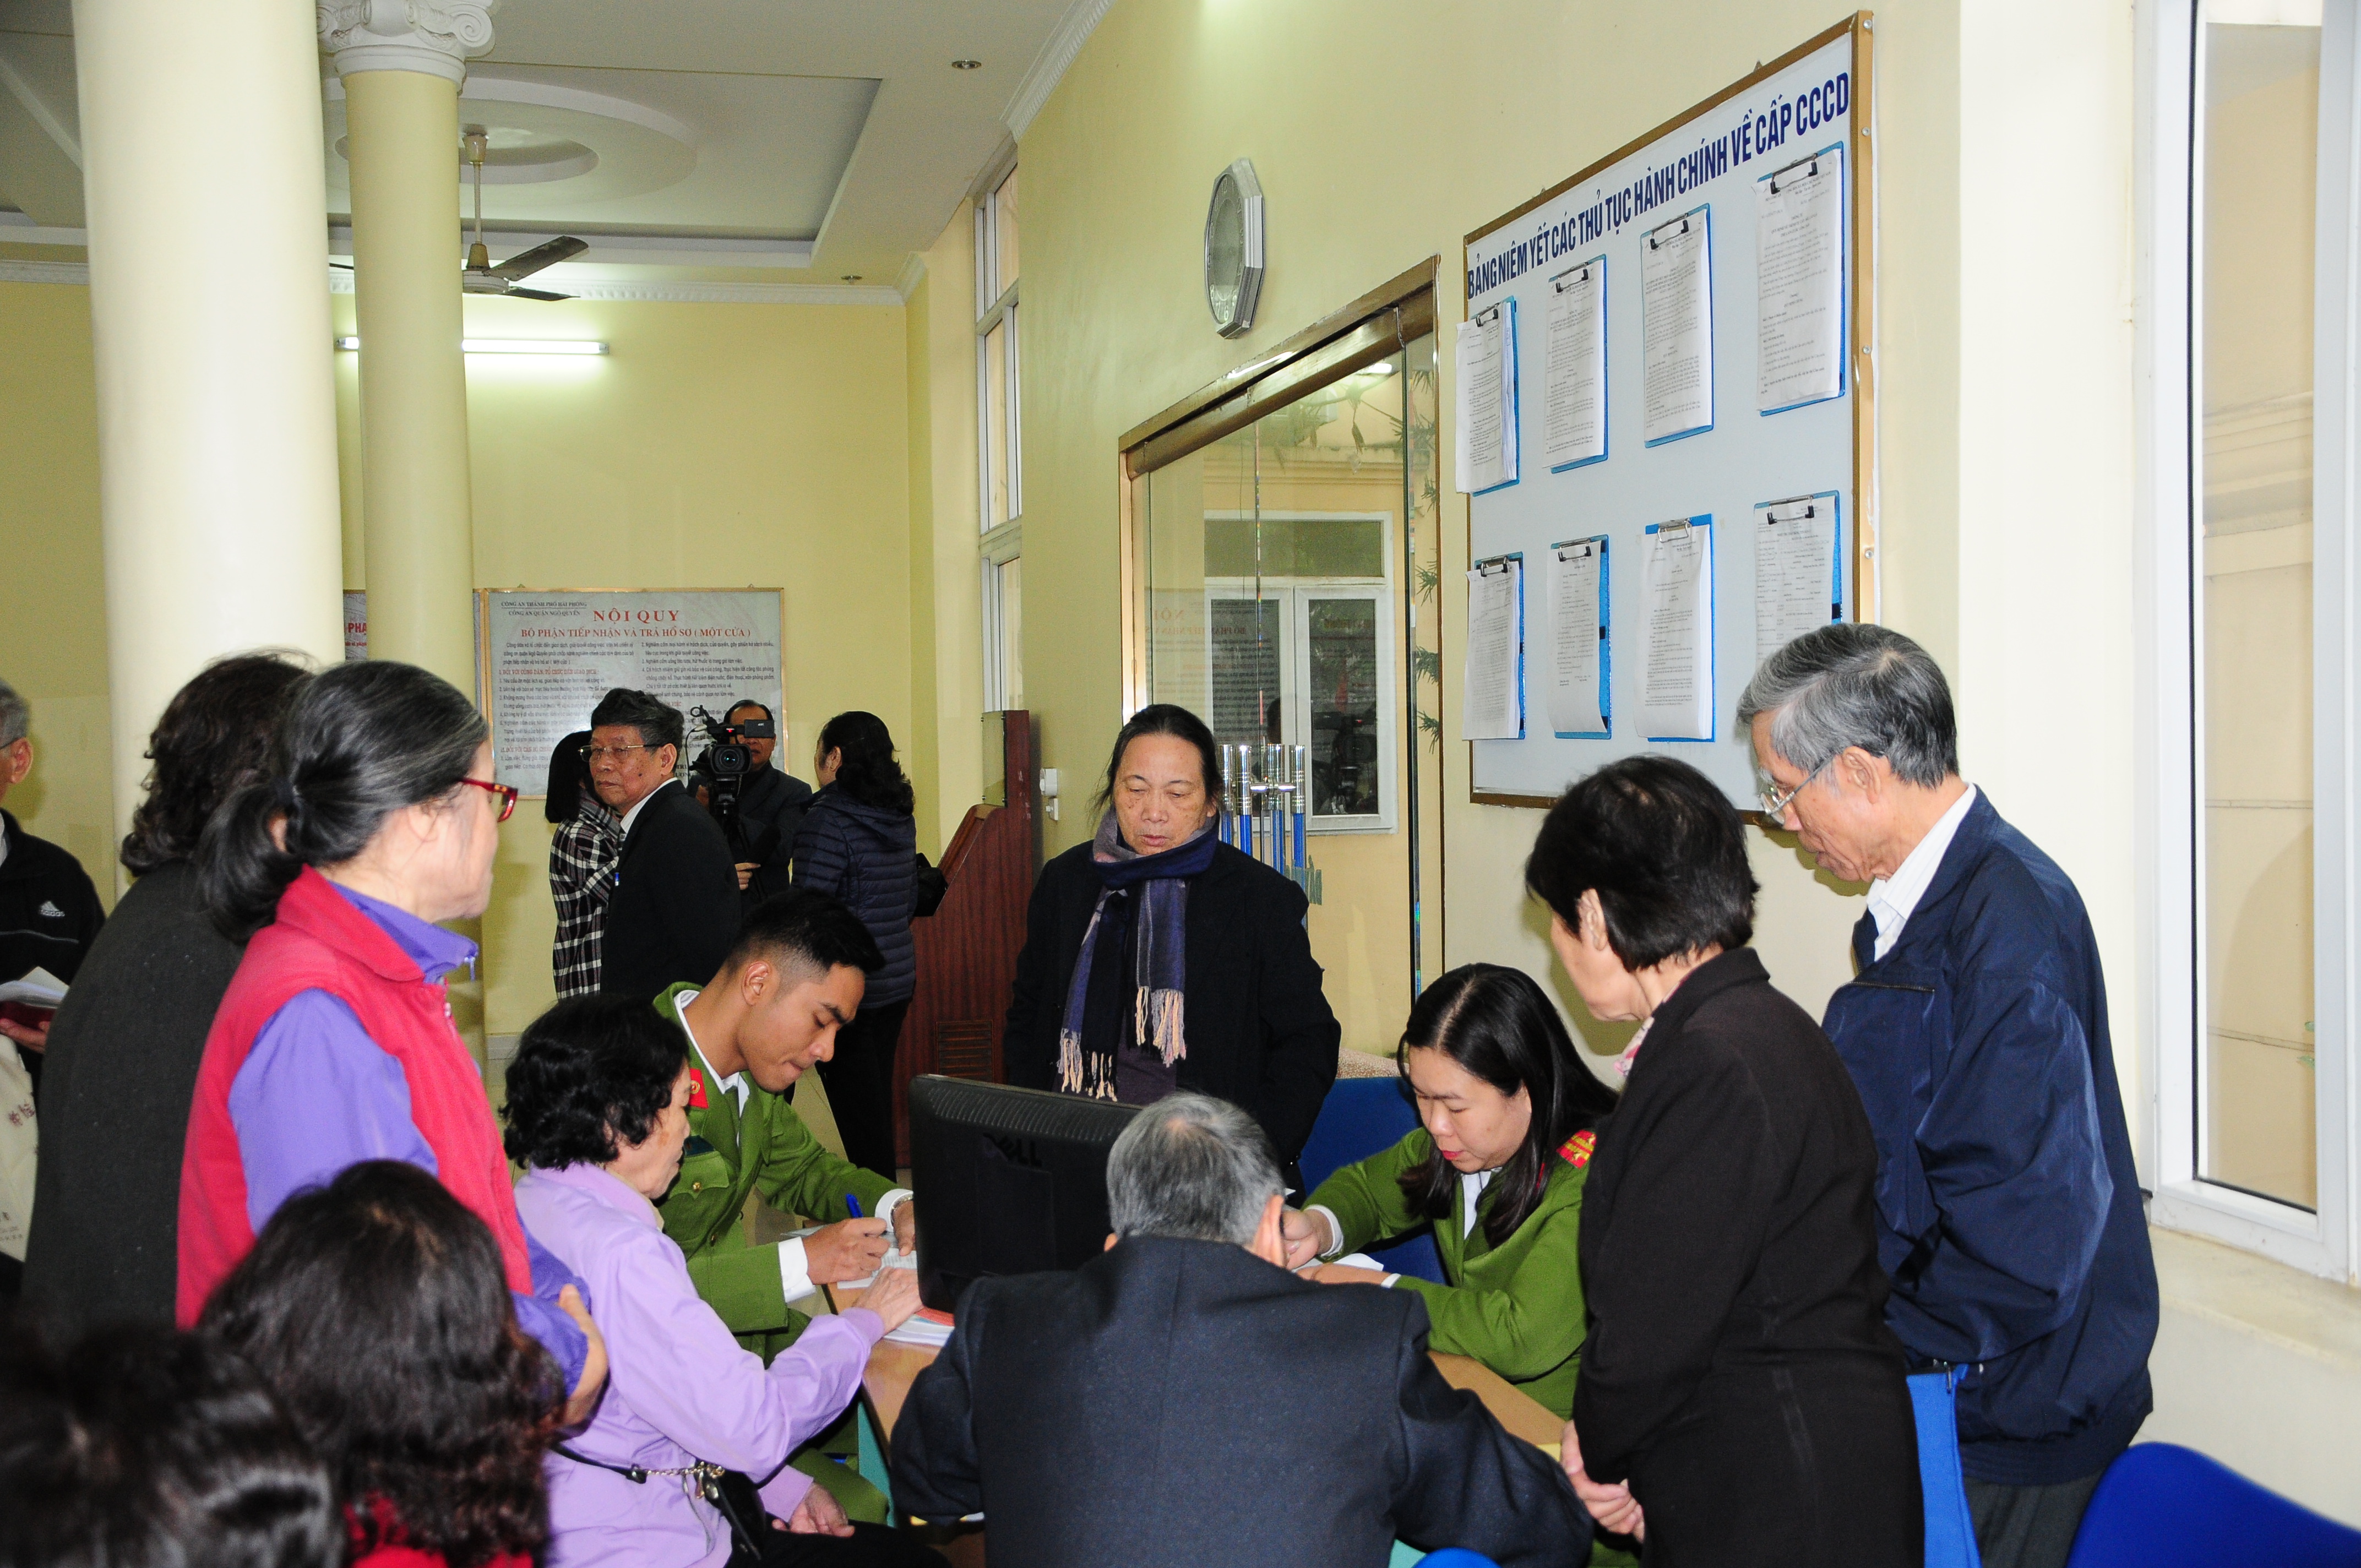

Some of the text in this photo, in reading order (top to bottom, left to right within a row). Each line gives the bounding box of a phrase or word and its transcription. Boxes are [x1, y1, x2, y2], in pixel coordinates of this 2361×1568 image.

[1468, 72, 1849, 300] BẢNG NIÊM YẾT CÁC THỦ TỤC HÀNH CHÍNH VỀ CẤP CCCD
[594, 608, 679, 624] NỘI QUY
[521, 628, 535, 639] BỘ
[538, 628, 565, 639] PHẬN
[567, 626, 590, 637] TIẾP
[593, 628, 621, 639] NHẬN
[624, 627, 637, 637] VÀ
[640, 627, 659, 636] TRẢ
[662, 626, 677, 636] HỒ
[700, 627, 722, 638] MỘT
[725, 626, 744, 636] CỬA
